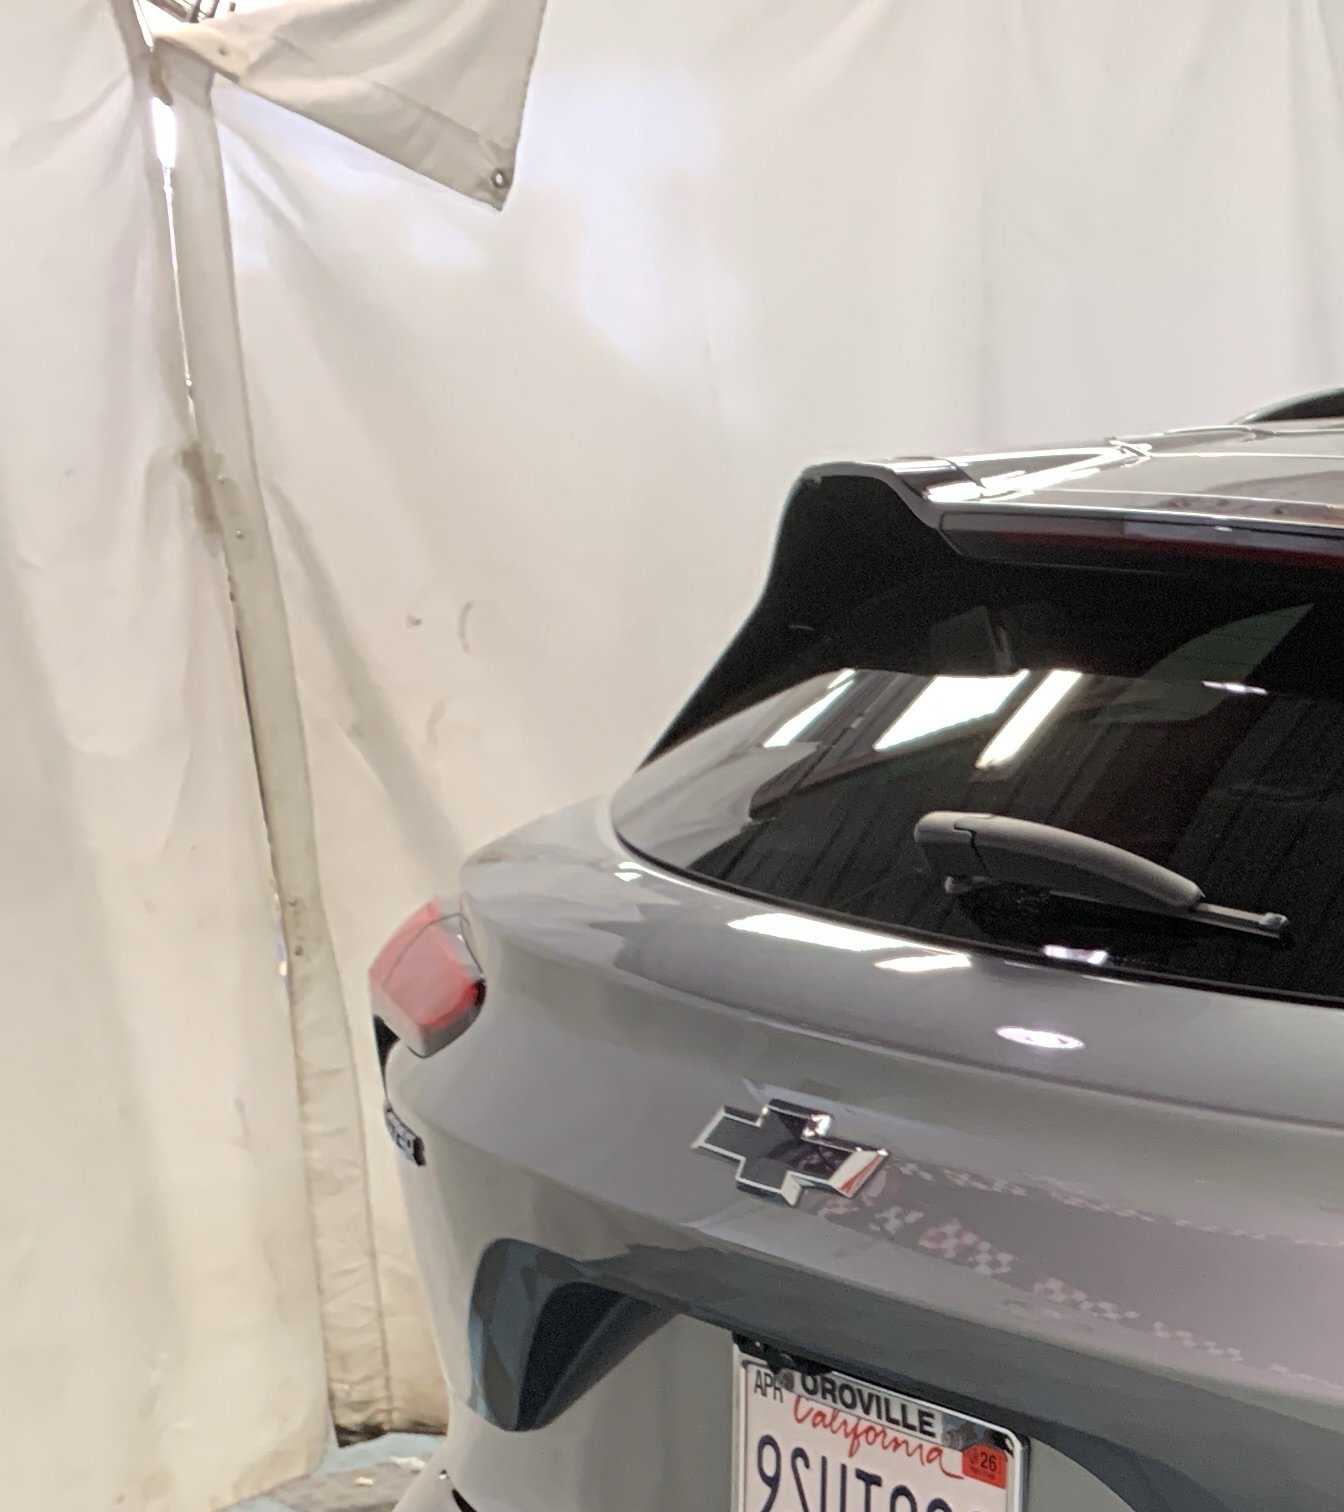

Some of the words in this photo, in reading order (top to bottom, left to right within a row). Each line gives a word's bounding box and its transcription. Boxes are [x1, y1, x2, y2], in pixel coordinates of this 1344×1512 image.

[793, 1395, 966, 1480] California
[800, 1374, 936, 1438] OROVILLE
[980, 1451, 997, 1472] 26
